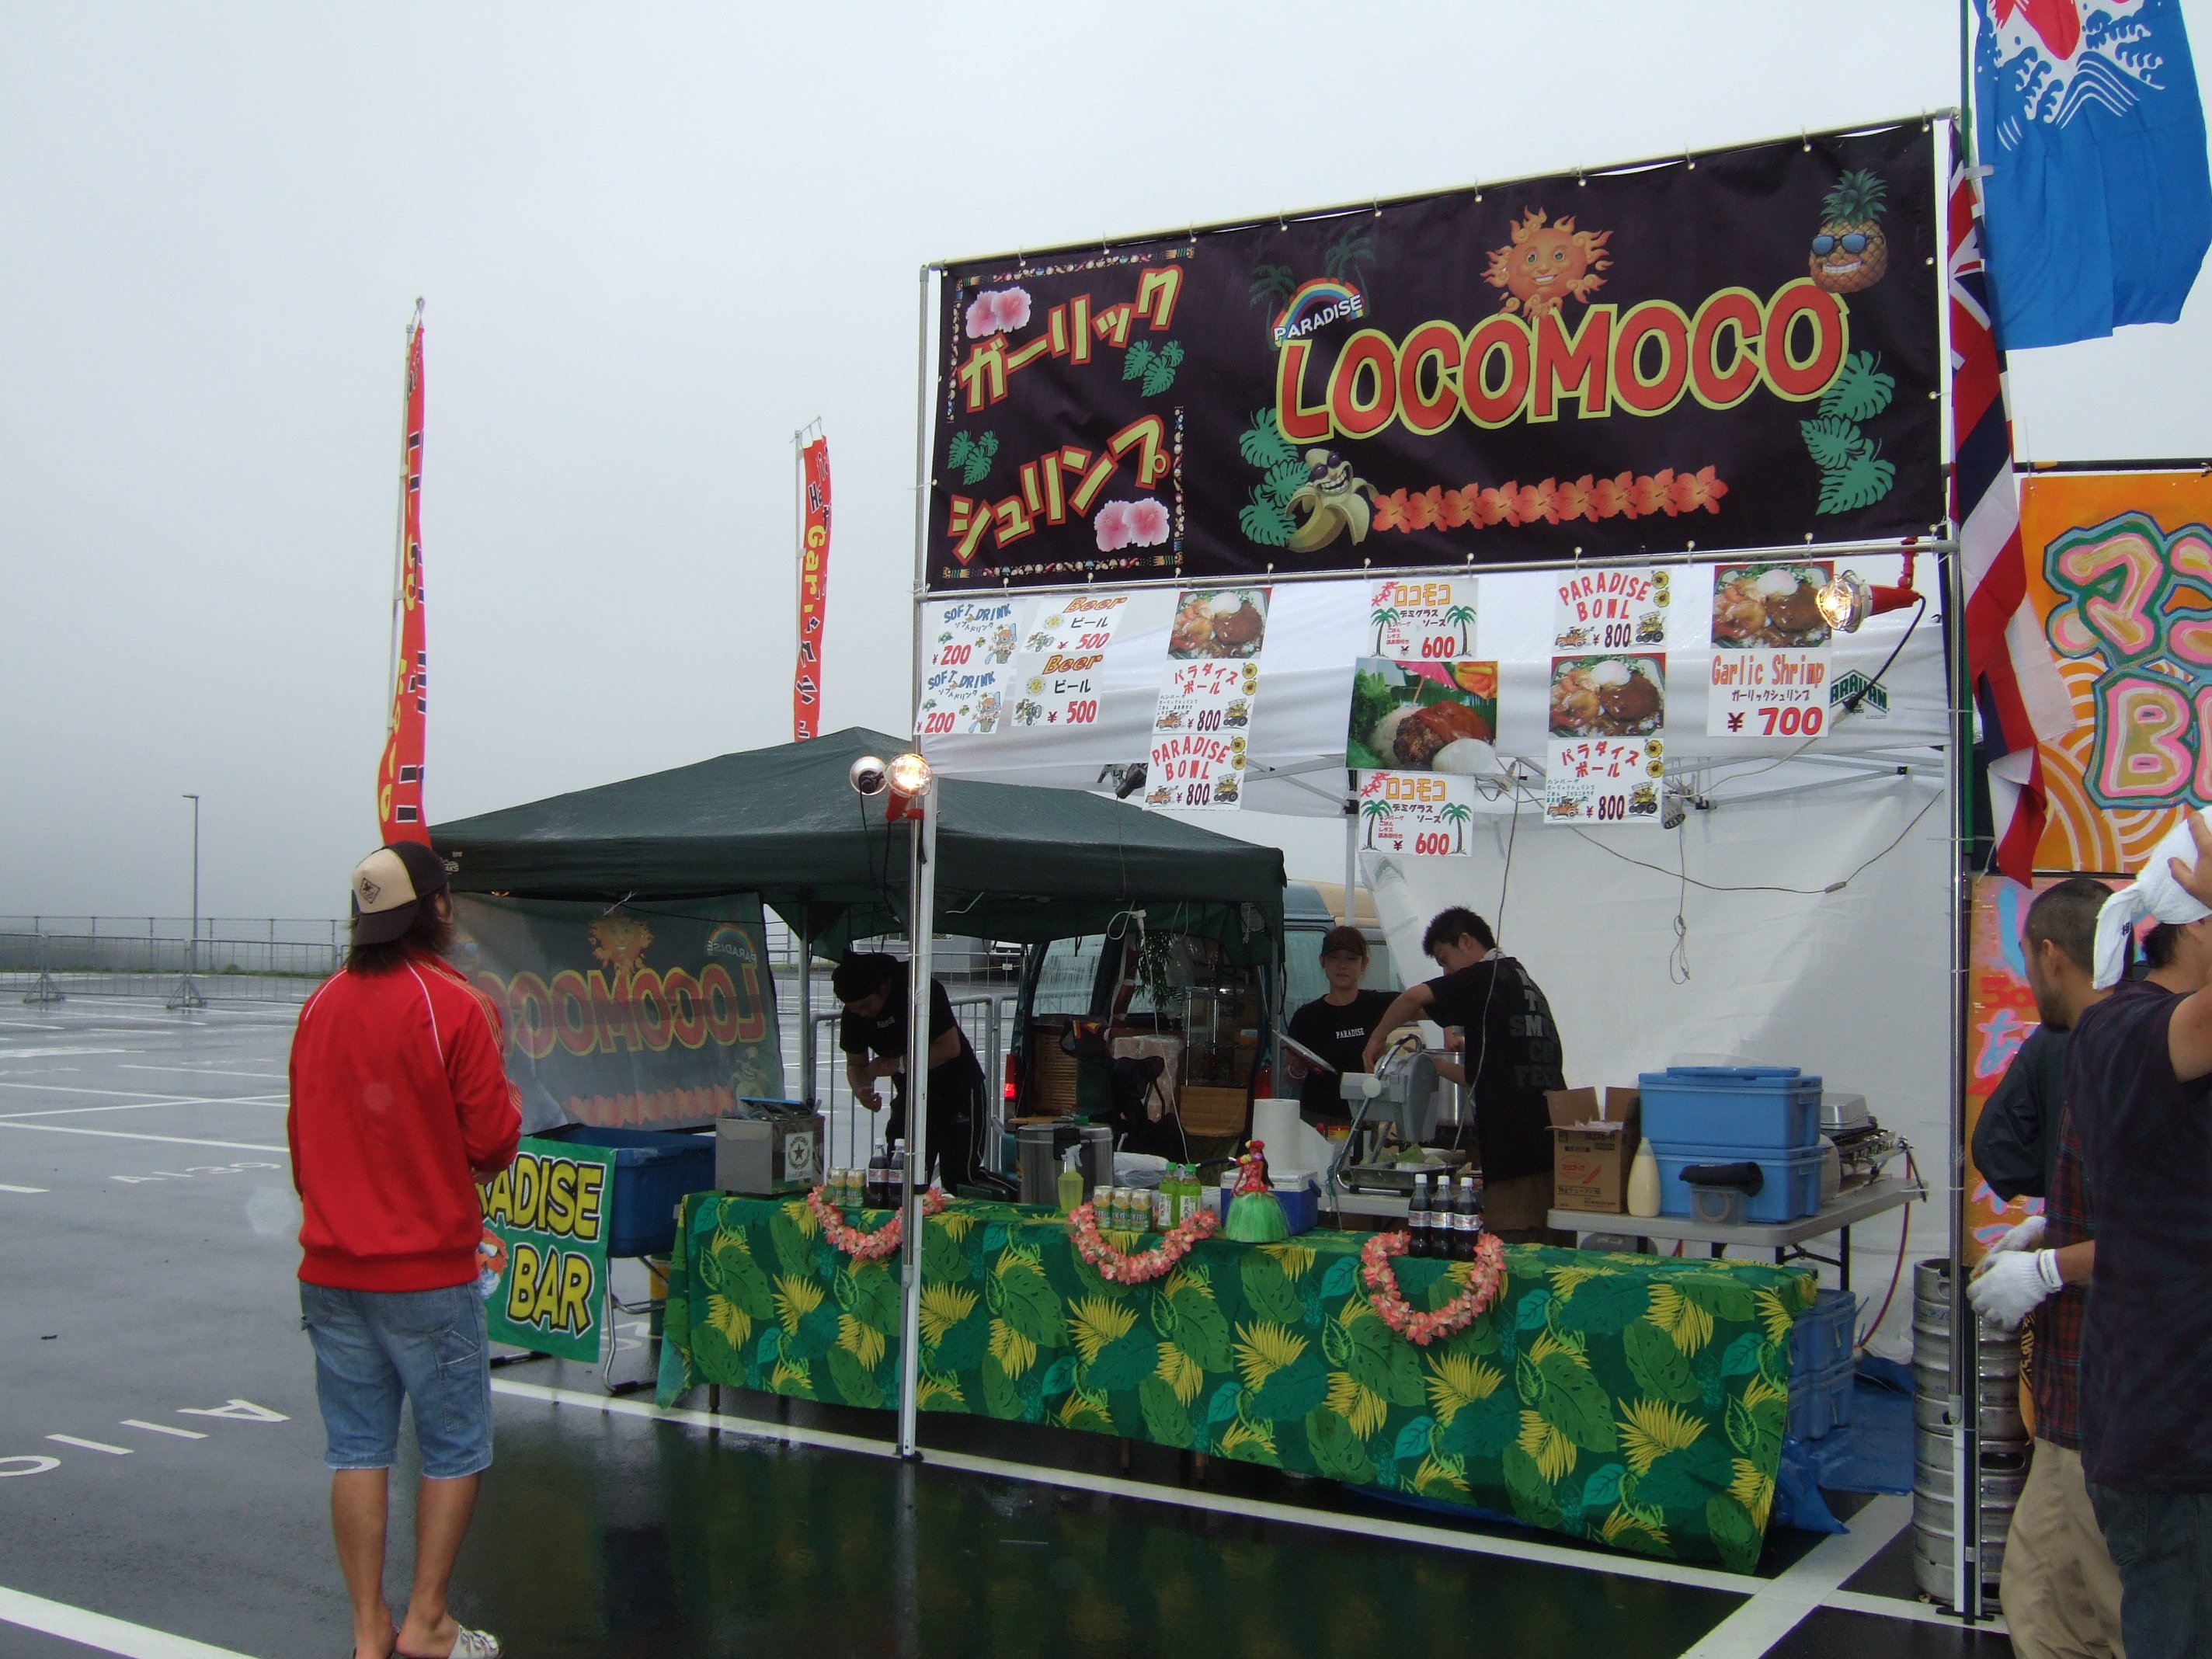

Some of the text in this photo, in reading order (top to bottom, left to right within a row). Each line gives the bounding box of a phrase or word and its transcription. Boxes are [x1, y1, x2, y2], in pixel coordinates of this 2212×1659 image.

[1273, 292, 1365, 342] PARADISE
[958, 264, 1184, 413] ガーリック
[1275, 276, 1850, 445] LOCOMOCO
[947, 413, 1171, 565] シュリンプ
[1394, 583, 1452, 607] ロコモコ
[1558, 572, 1650, 607] PARADISE
[944, 603, 1011, 623] SOFT DRINK
[1063, 596, 1127, 614] Beer
[1400, 609, 1438, 618] デミグラス
[1576, 598, 1629, 622] BOWL
[1070, 617, 1109, 628] ビール
[1422, 618, 1446, 628] ソース
[1076, 633, 1110, 650] 500
[1605, 623, 1631, 649] 800
[941, 645, 971, 665] 200
[1421, 636, 1456, 659] 600
[1042, 654, 1103, 675] Beer
[1174, 663, 1239, 685] パラダイス
[1711, 654, 1824, 688] Garlic Shrimp
[927, 670, 996, 690] SOFT DRINK
[1055, 679, 1091, 694] ビール
[1184, 680, 1220, 695] ボール
[1732, 689, 1810, 701] ガーリックシュリンプ
[924, 712, 955, 733] 200
[1066, 700, 1097, 724] 500
[1197, 709, 1221, 732] 800
[1758, 707, 1823, 736] 700
[1152, 736, 1231, 767] PARADISE
[1562, 740, 1639, 767] パラダイス
[1165, 760, 1209, 781] BOWL
[1575, 761, 1620, 778] ボール
[1186, 783, 1210, 806] 800
[1386, 777, 1445, 802] ロコモコ
[1392, 803, 1433, 813] デミグラス
[1417, 814, 1442, 823] ソース
[1598, 795, 1625, 820] 800
[1415, 833, 1449, 855] 600
[1336, 1028, 1365, 1039] PARADISE
[507, 1243, 594, 1339] BAR
